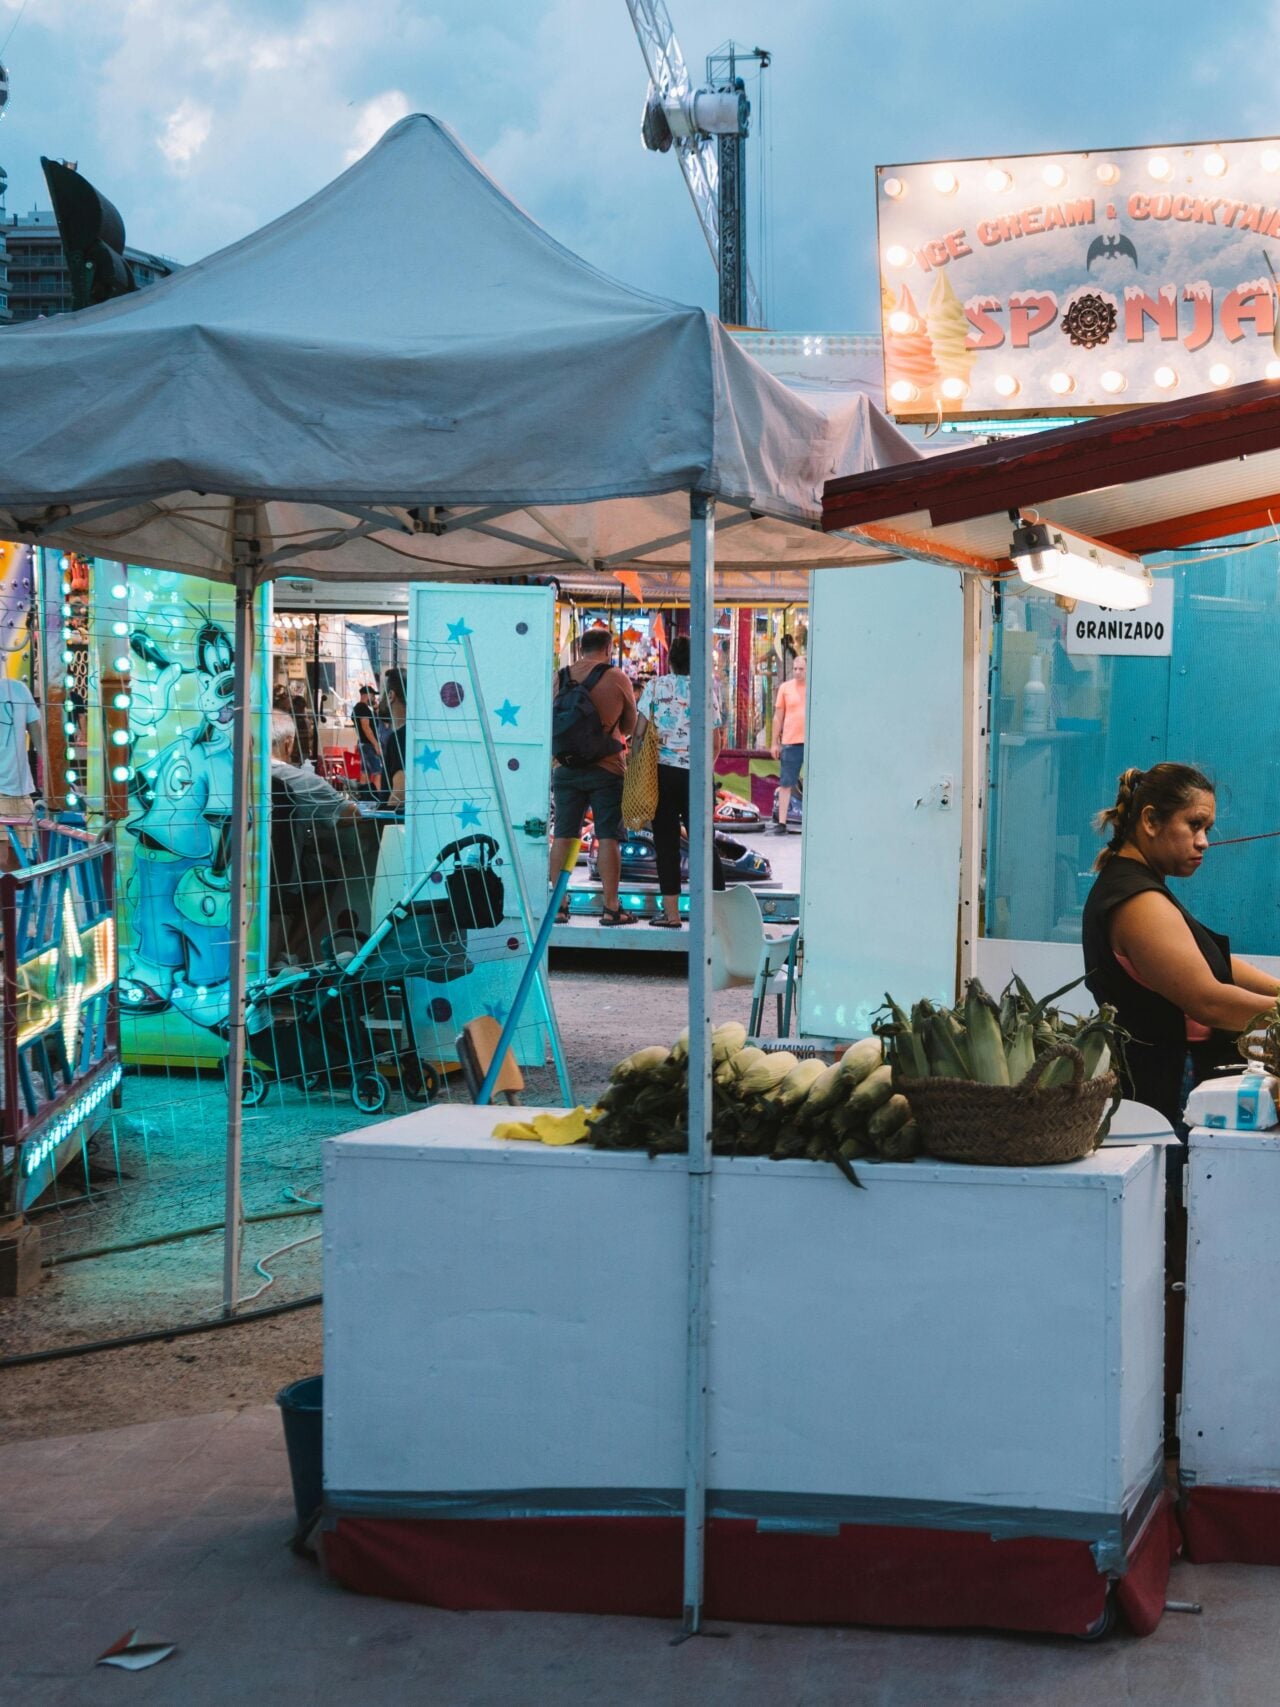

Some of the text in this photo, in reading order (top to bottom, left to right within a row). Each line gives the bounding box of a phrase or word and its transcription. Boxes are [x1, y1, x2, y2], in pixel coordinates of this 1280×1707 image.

[914, 227, 973, 273] ICE
[976, 197, 1096, 247] CREAM
[1076, 620, 1164, 640] GRANIZADO
